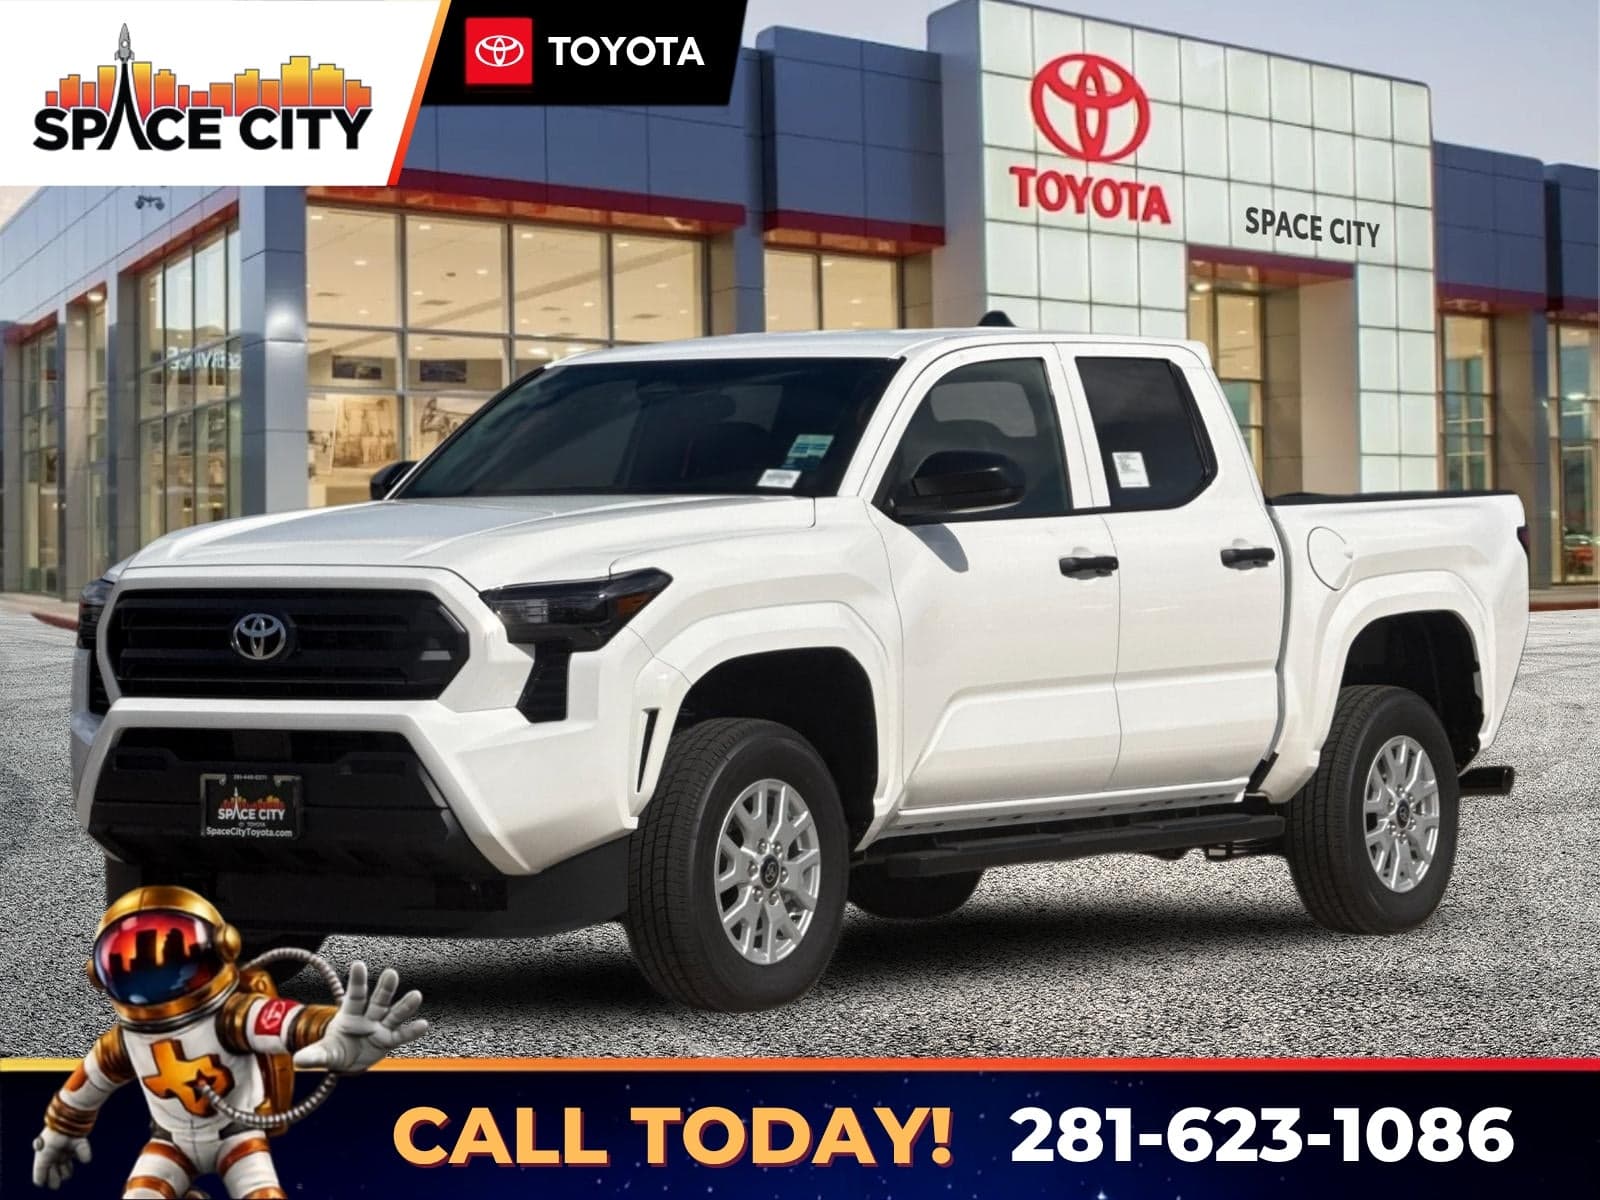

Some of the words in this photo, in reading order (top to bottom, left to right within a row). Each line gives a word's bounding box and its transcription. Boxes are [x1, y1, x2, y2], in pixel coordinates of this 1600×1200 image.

[1009, 166, 1171, 224] TOYOTA
[1245, 206, 1323, 242] SPACE
[1329, 217, 1381, 248] CITY
[217, 806, 257, 820] SPACE
[258, 808, 286, 820] CITY
[206, 826, 293, 838] SpaceCityToyota.com
